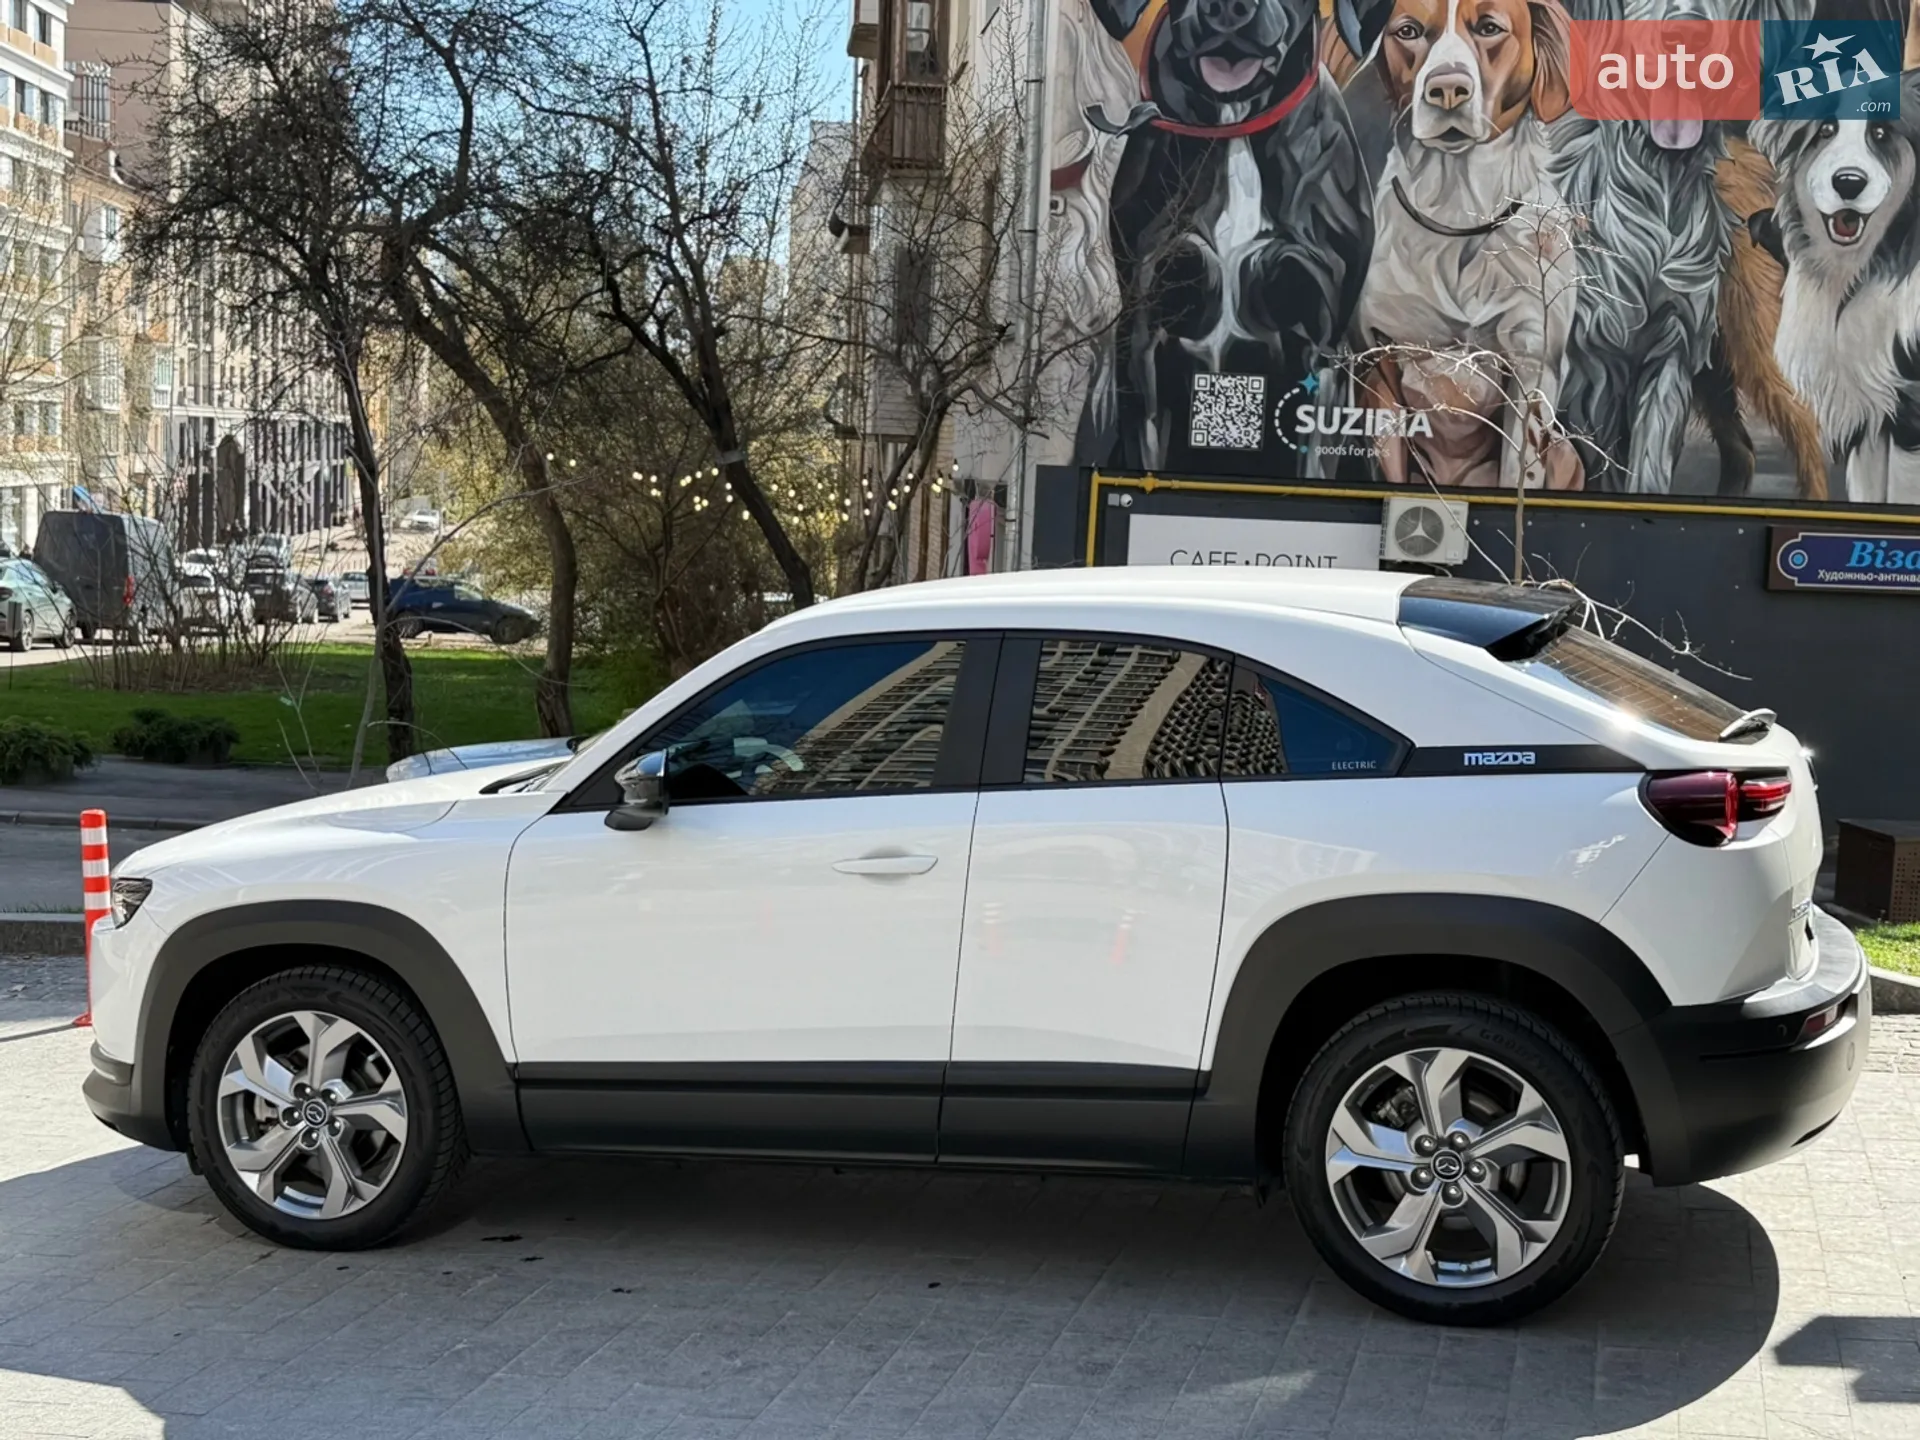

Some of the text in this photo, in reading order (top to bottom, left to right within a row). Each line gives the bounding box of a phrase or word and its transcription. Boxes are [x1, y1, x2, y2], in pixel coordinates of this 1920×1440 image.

[1314, 444, 1347, 457] goods
[1349, 445, 1366, 457] for
[1331, 760, 1377, 770] ELECTRIC
